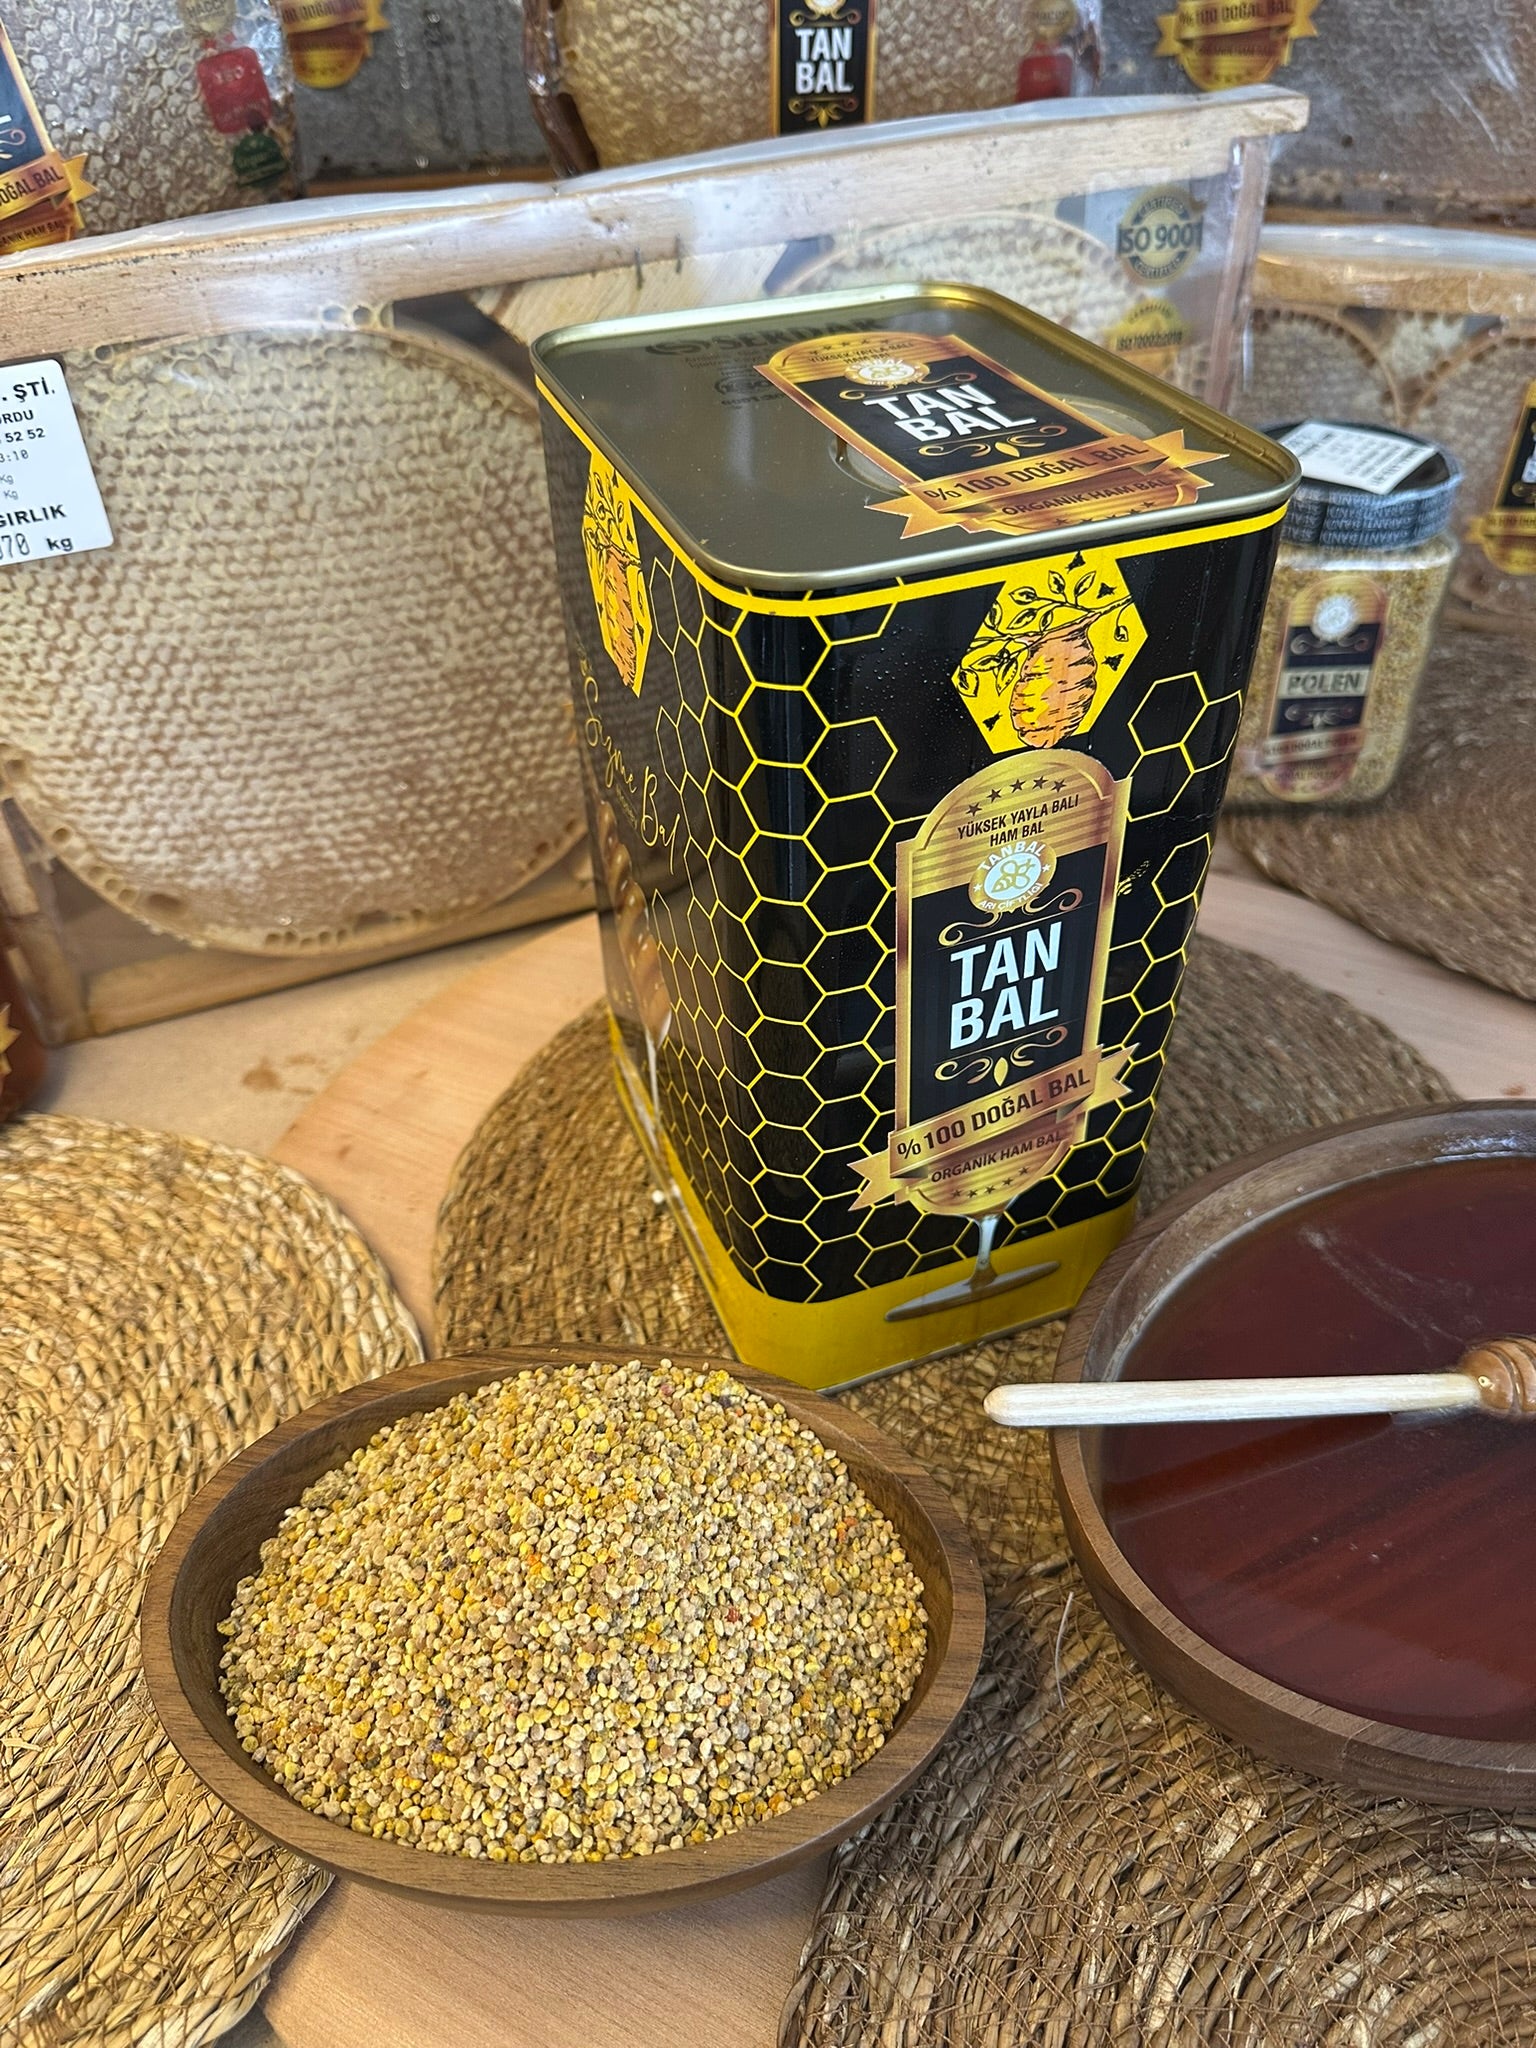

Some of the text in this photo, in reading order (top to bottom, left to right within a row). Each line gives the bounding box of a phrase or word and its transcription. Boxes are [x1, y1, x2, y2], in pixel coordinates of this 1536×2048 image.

[795, 27, 853, 61] TAN
[795, 61, 855, 94] BAL
[32, 166, 64, 189] BAL
[13, 376, 56, 403] ŞTİ.
[863, 384, 997, 420] TAN
[0, 409, 34, 424] RDU
[894, 405, 1037, 442] BAL
[5, 427, 46, 443] 52 52
[1004, 456, 1099, 483] DOĞAL
[1093, 443, 1150, 463] BAL
[1087, 484, 1138, 500] HAM
[1136, 477, 1170, 491] BAL
[46, 537, 74, 552] kg
[1286, 672, 1361, 695] POLEN
[957, 794, 1080, 839] YÜKSEK YAYLA BALI
[990, 821, 1045, 847] HAM BAL
[977, 841, 1047, 871] TANBAL
[949, 921, 1064, 997] TAN
[949, 976, 1060, 1051] BAL
[971, 1088, 1044, 1132] DOĞAL
[1047, 1068, 1091, 1099] BAL
[930, 1130, 1065, 1183] ORGANİK HAM BAL
